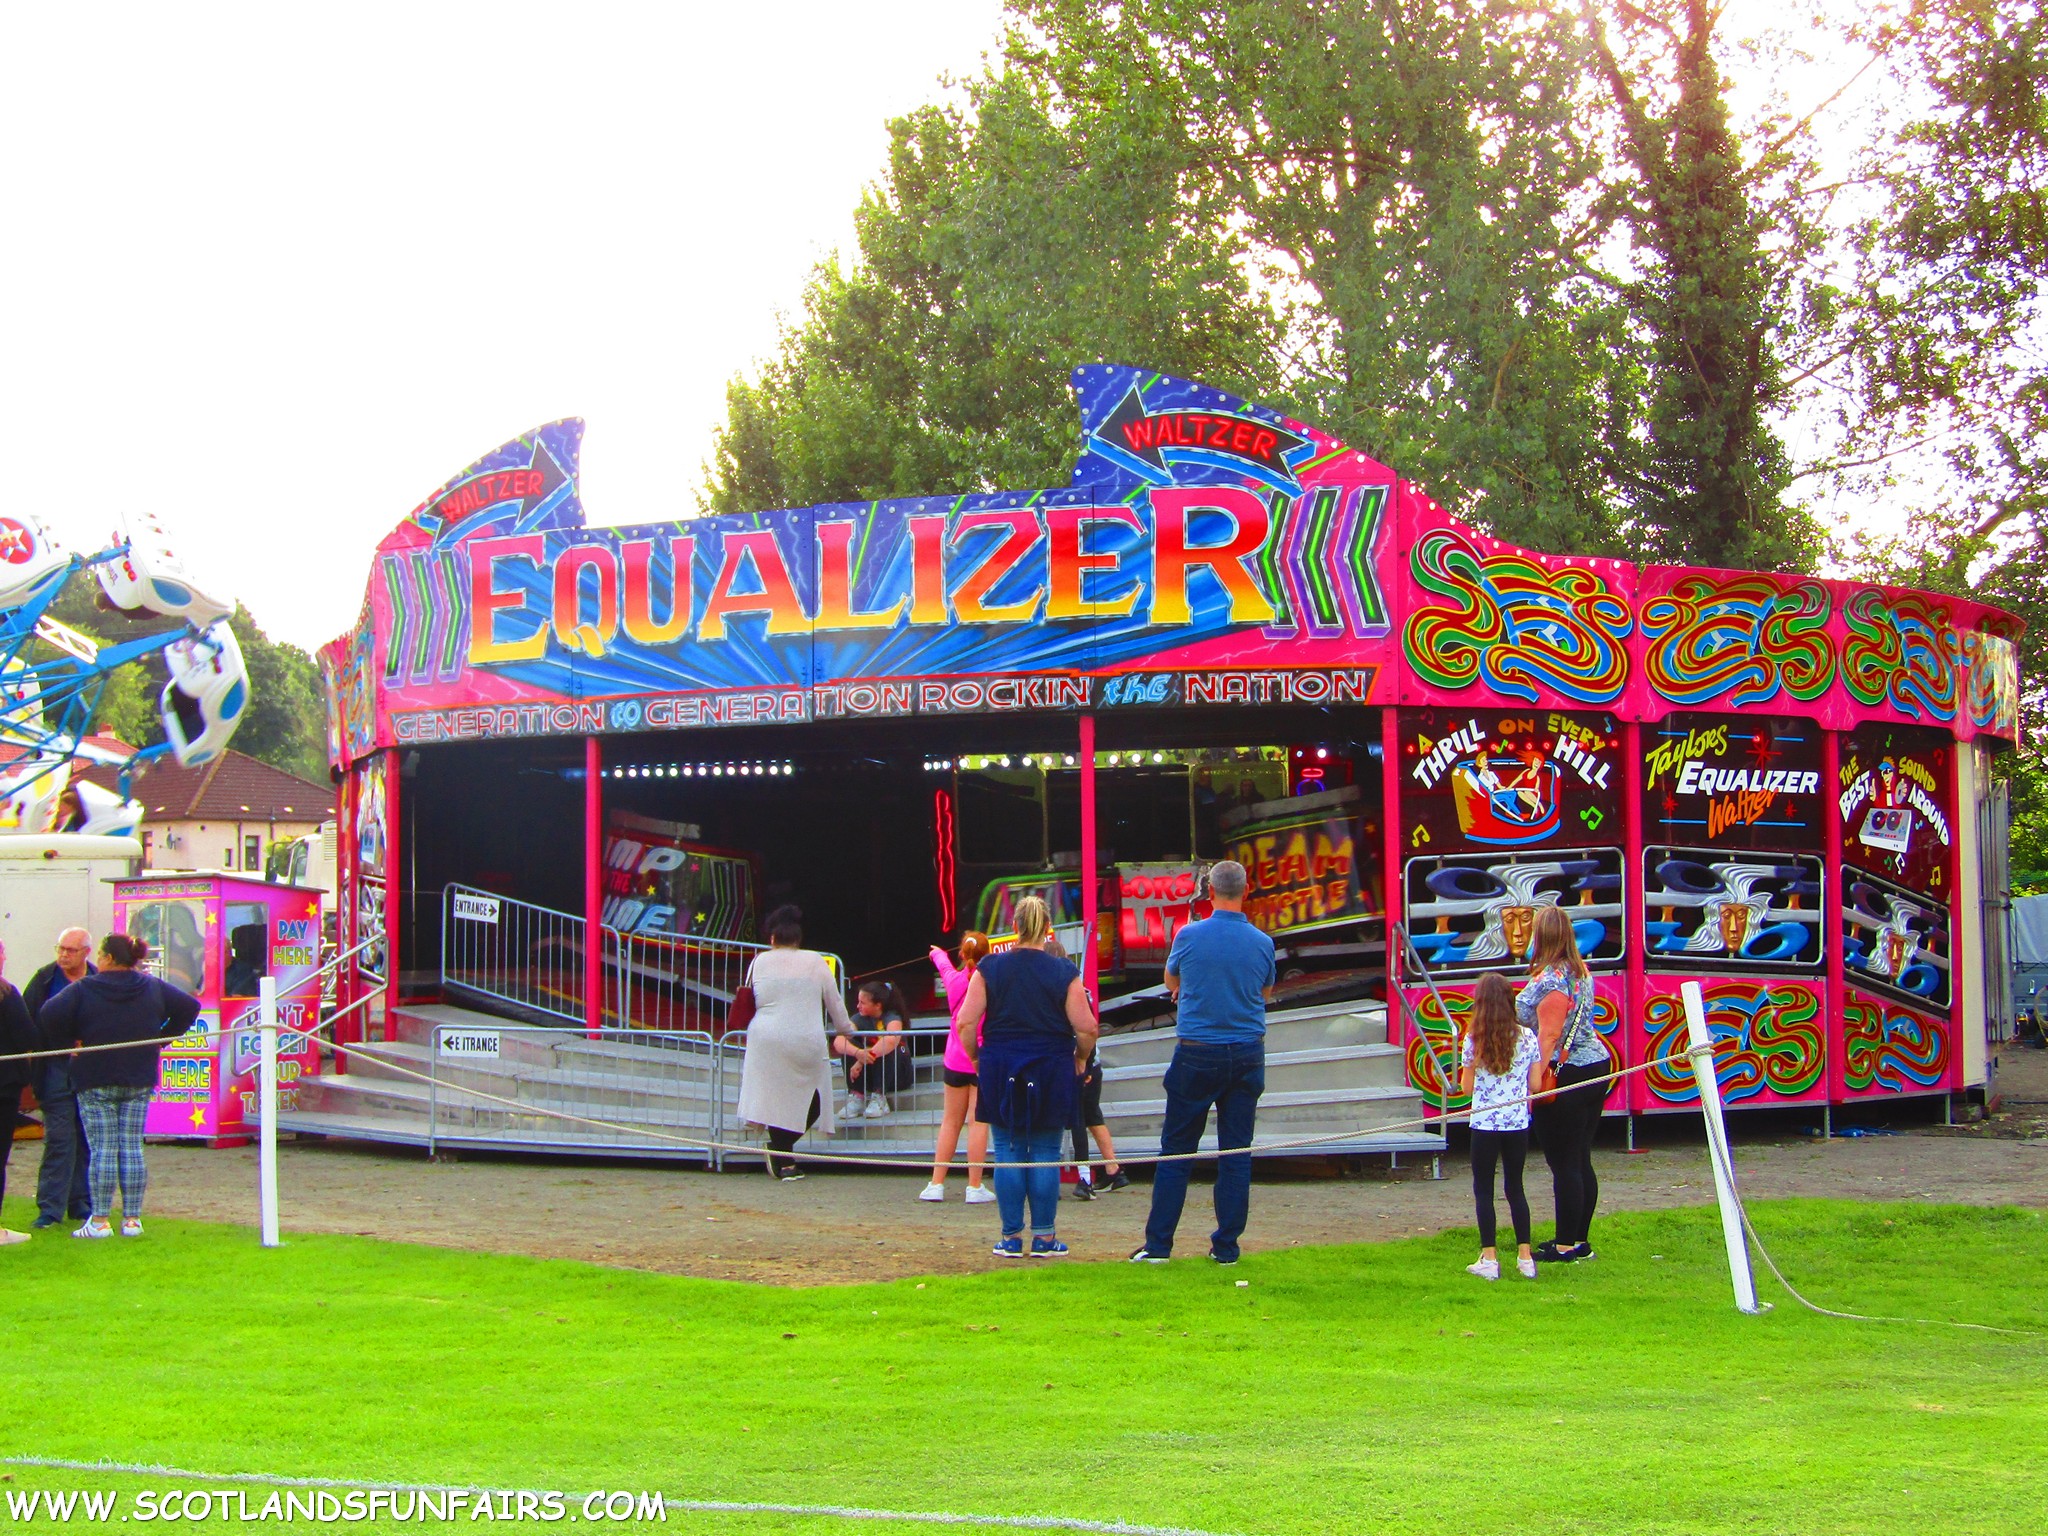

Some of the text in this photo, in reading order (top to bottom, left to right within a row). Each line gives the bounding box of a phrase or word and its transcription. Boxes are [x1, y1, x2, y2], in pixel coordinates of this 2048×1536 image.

[1122, 415, 1278, 461] WALTZER
[439, 469, 546, 524] WALTZER
[467, 483, 1279, 668] EQUALIZER
[395, 699, 606, 740] GENERATION
[646, 681, 912, 726] GENERATION
[918, 675, 1091, 714] ROCKIN
[1103, 673, 1173, 705] the
[1184, 671, 1367, 704] NATION
[1412, 713, 1611, 791] A THRILL ON EVERY HILL
[1676, 761, 1819, 796] EQUALIZER
[1839, 754, 1949, 846] THE BEST SOUND AROUND
[1226, 832, 1354, 894] REAM
[277, 919, 309, 941] PAY
[455, 899, 488, 916] ENTRANCE
[273, 946, 313, 967] HERE
[162, 1059, 211, 1088] HERE
